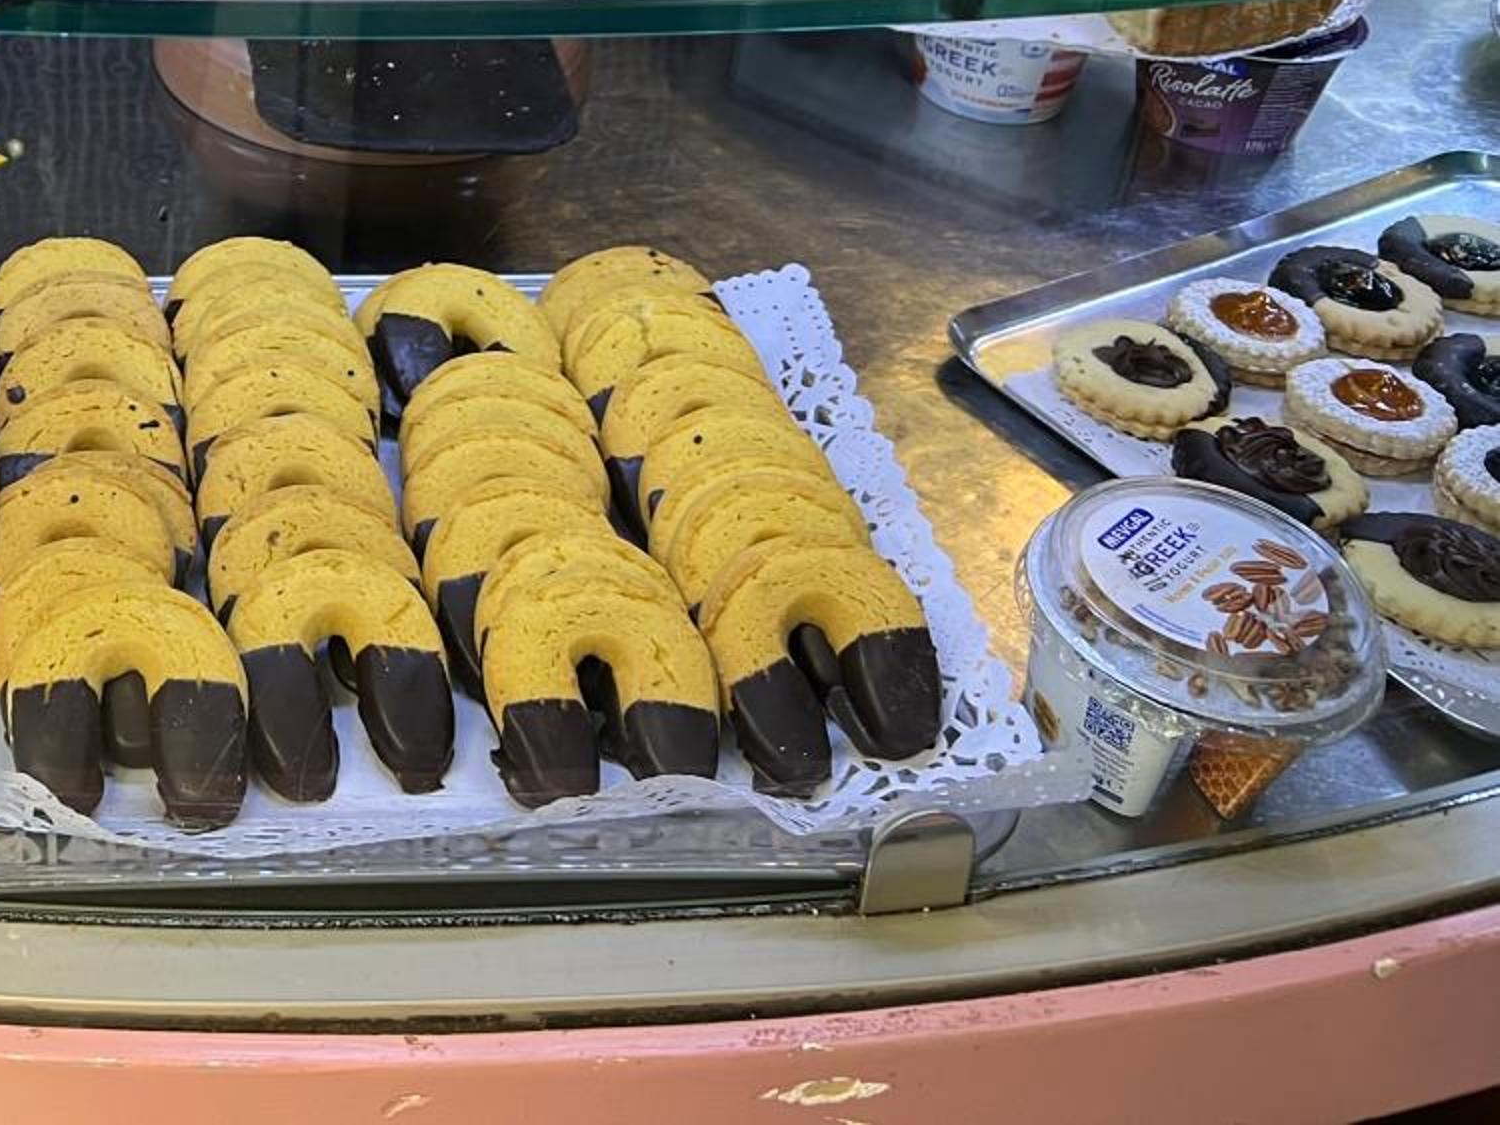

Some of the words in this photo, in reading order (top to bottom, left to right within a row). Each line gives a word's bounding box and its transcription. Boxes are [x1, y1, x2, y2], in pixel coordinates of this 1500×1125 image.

[1150, 63, 1260, 102] Risolatte
[1100, 512, 1152, 547] MEVGAL
[1130, 527, 1197, 577] GREEK
